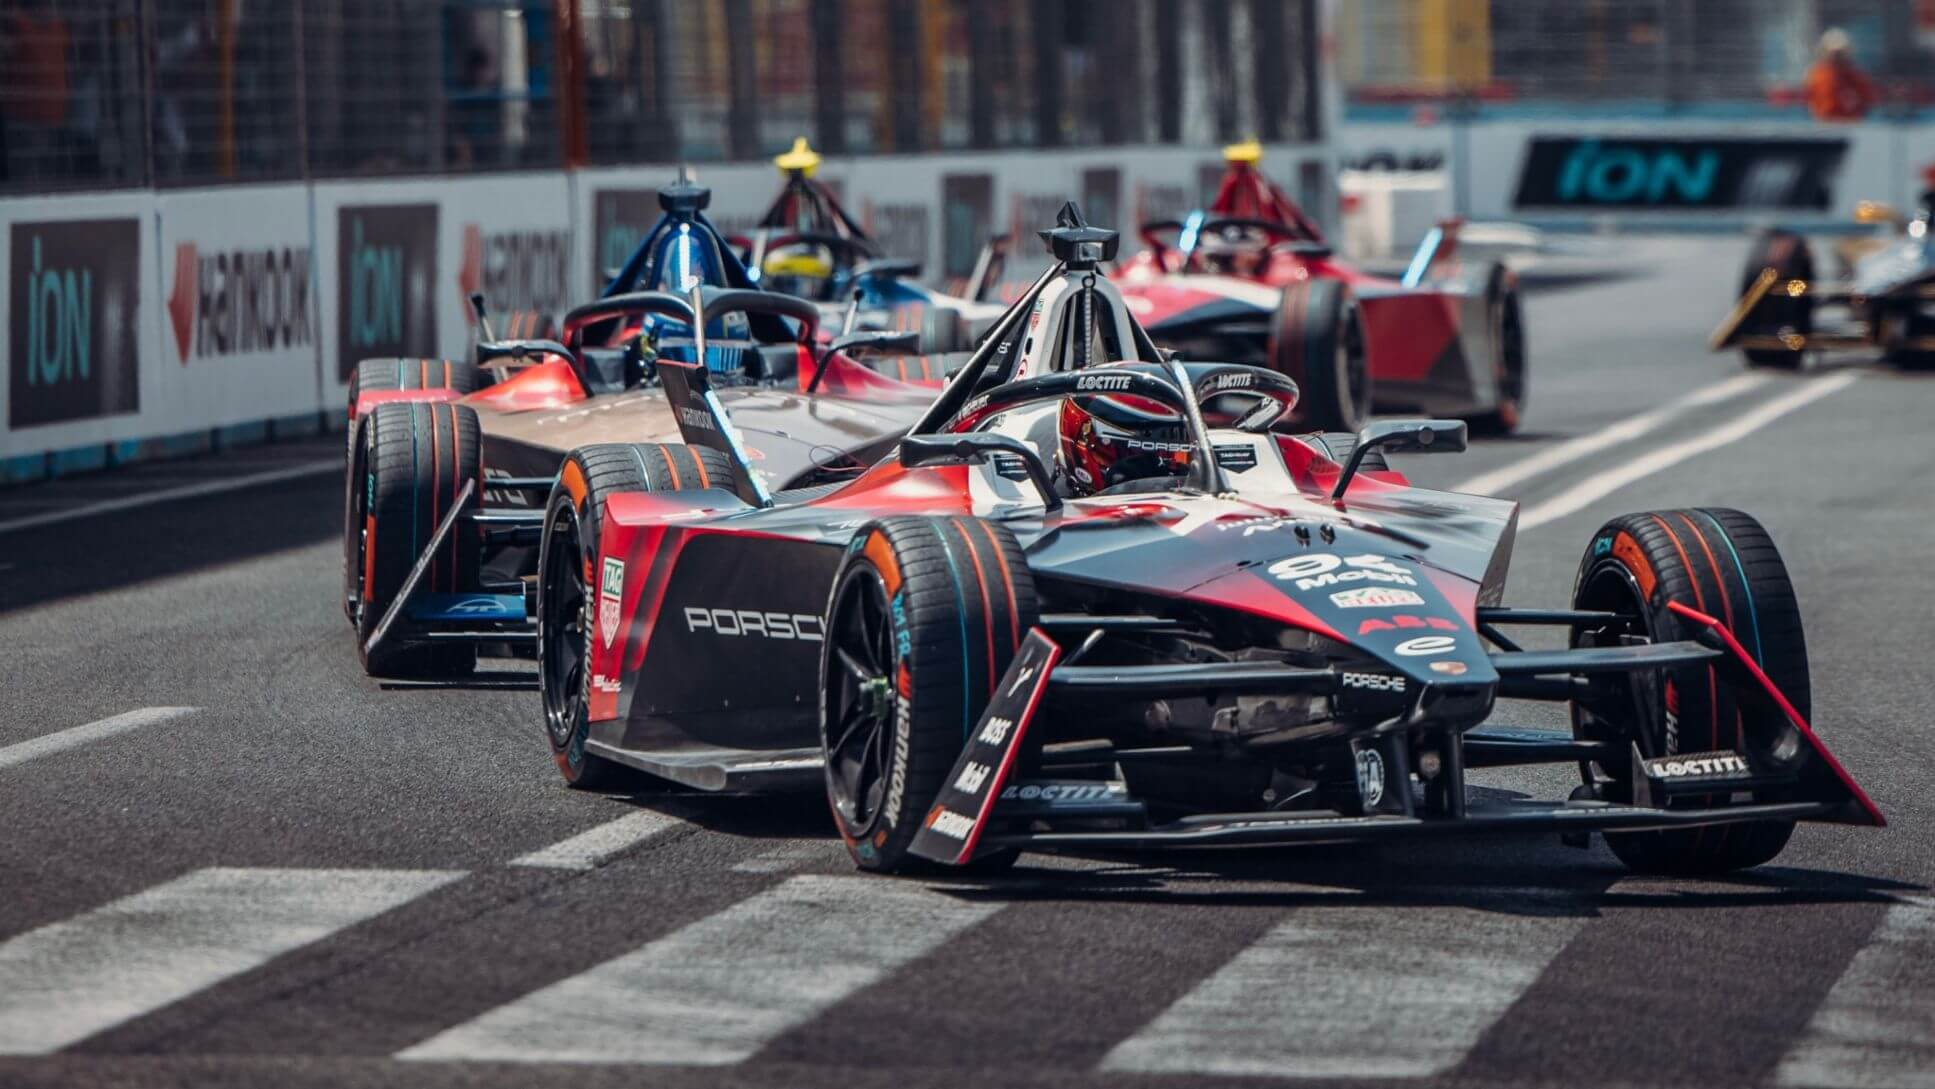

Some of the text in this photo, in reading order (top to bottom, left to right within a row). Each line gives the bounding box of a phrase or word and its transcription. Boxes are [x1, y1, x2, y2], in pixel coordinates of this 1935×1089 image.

[1077, 375, 1132, 390] LOCTITE
[1217, 373, 1252, 389] LOCTITE
[1127, 440, 1199, 452] PORSCH
[604, 563, 622, 596] TAG
[1343, 672, 1405, 692] PORSCHE
